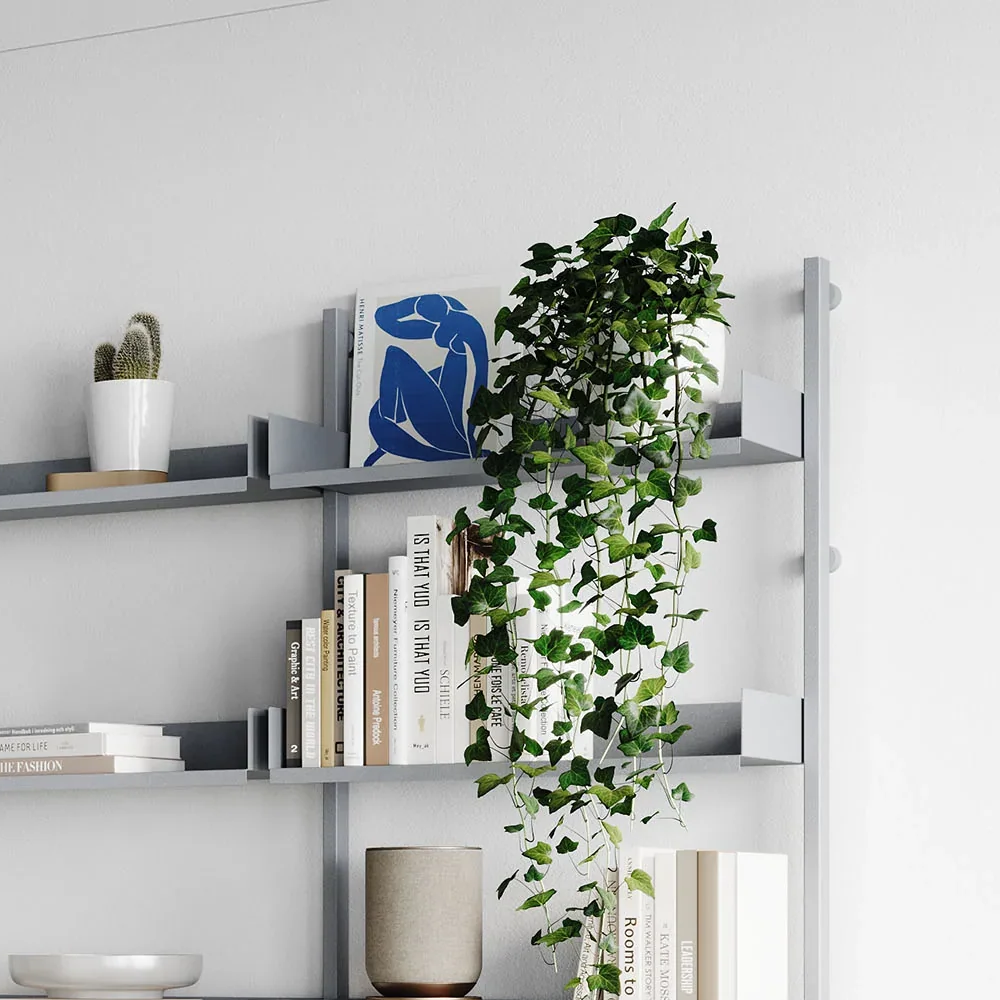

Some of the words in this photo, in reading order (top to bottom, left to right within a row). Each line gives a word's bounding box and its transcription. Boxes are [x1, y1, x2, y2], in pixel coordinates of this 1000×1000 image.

[414, 533, 430, 544] IS
[414, 550, 430, 578] THAT
[414, 584, 430, 607] YUO
[348, 591, 358, 632] Texture
[322, 619, 330, 635] Water
[414, 620, 430, 631] IS
[322, 636, 330, 649] color
[348, 634, 358, 644] to
[414, 636, 430, 664] THAT
[288, 642, 300, 675] Graphic
[321, 650, 330, 671] Painting
[348, 648, 358, 676] Paint
[414, 668, 430, 694] YUO
[491, 676, 502, 693] FOIS
[520, 646, 529, 704] Remoelista
[290, 685, 300, 700] Art
[372, 690, 382, 715] Antoine
[439, 669, 450, 720] SCHIELE
[491, 695, 502, 704] LE
[372, 718, 382, 746] Predock
[17, 742, 32, 751] FOR
[33, 742, 48, 751] LIFE
[17, 760, 63, 772] FASHION
[644, 914, 652, 928] TIM
[624, 917, 637, 973] Rooms
[644, 932, 652, 965] WALKER
[660, 933, 670, 965] KATE
[680, 940, 694, 994] LEADERSHIP
[624, 979, 636, 996] to
[644, 969, 652, 996] STORY
